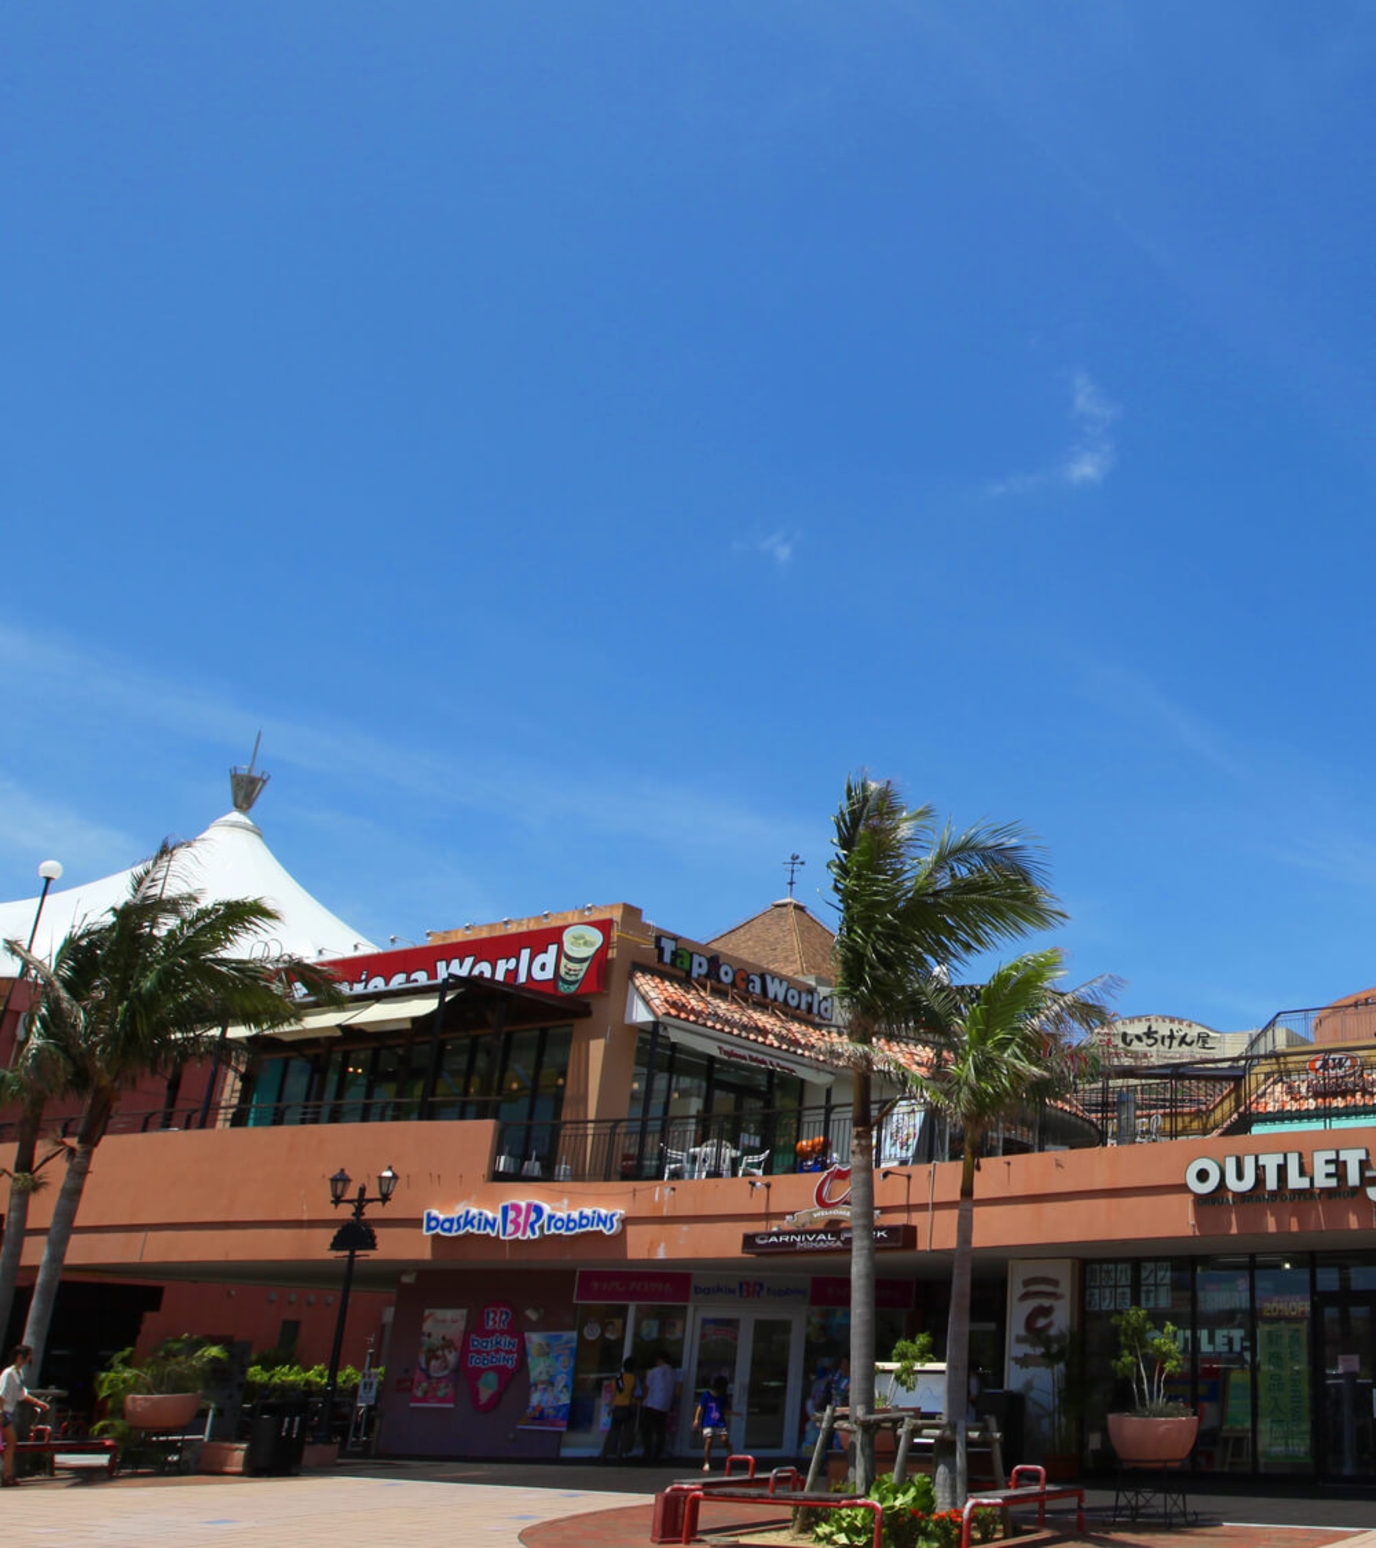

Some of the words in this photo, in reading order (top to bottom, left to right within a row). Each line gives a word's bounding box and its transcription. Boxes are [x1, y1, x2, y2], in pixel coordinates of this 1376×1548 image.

[436, 943, 559, 987] World
[657, 936, 762, 994] Tapioca
[764, 973, 834, 1020] World
[1121, 1024, 1216, 1050] いちげん屋
[425, 1210, 498, 1234] baskin
[546, 1210, 619, 1233] robbins
[755, 1233, 836, 1245] CARNIVAL
[470, 1333, 518, 1349] baskin
[468, 1352, 516, 1369] robbins
